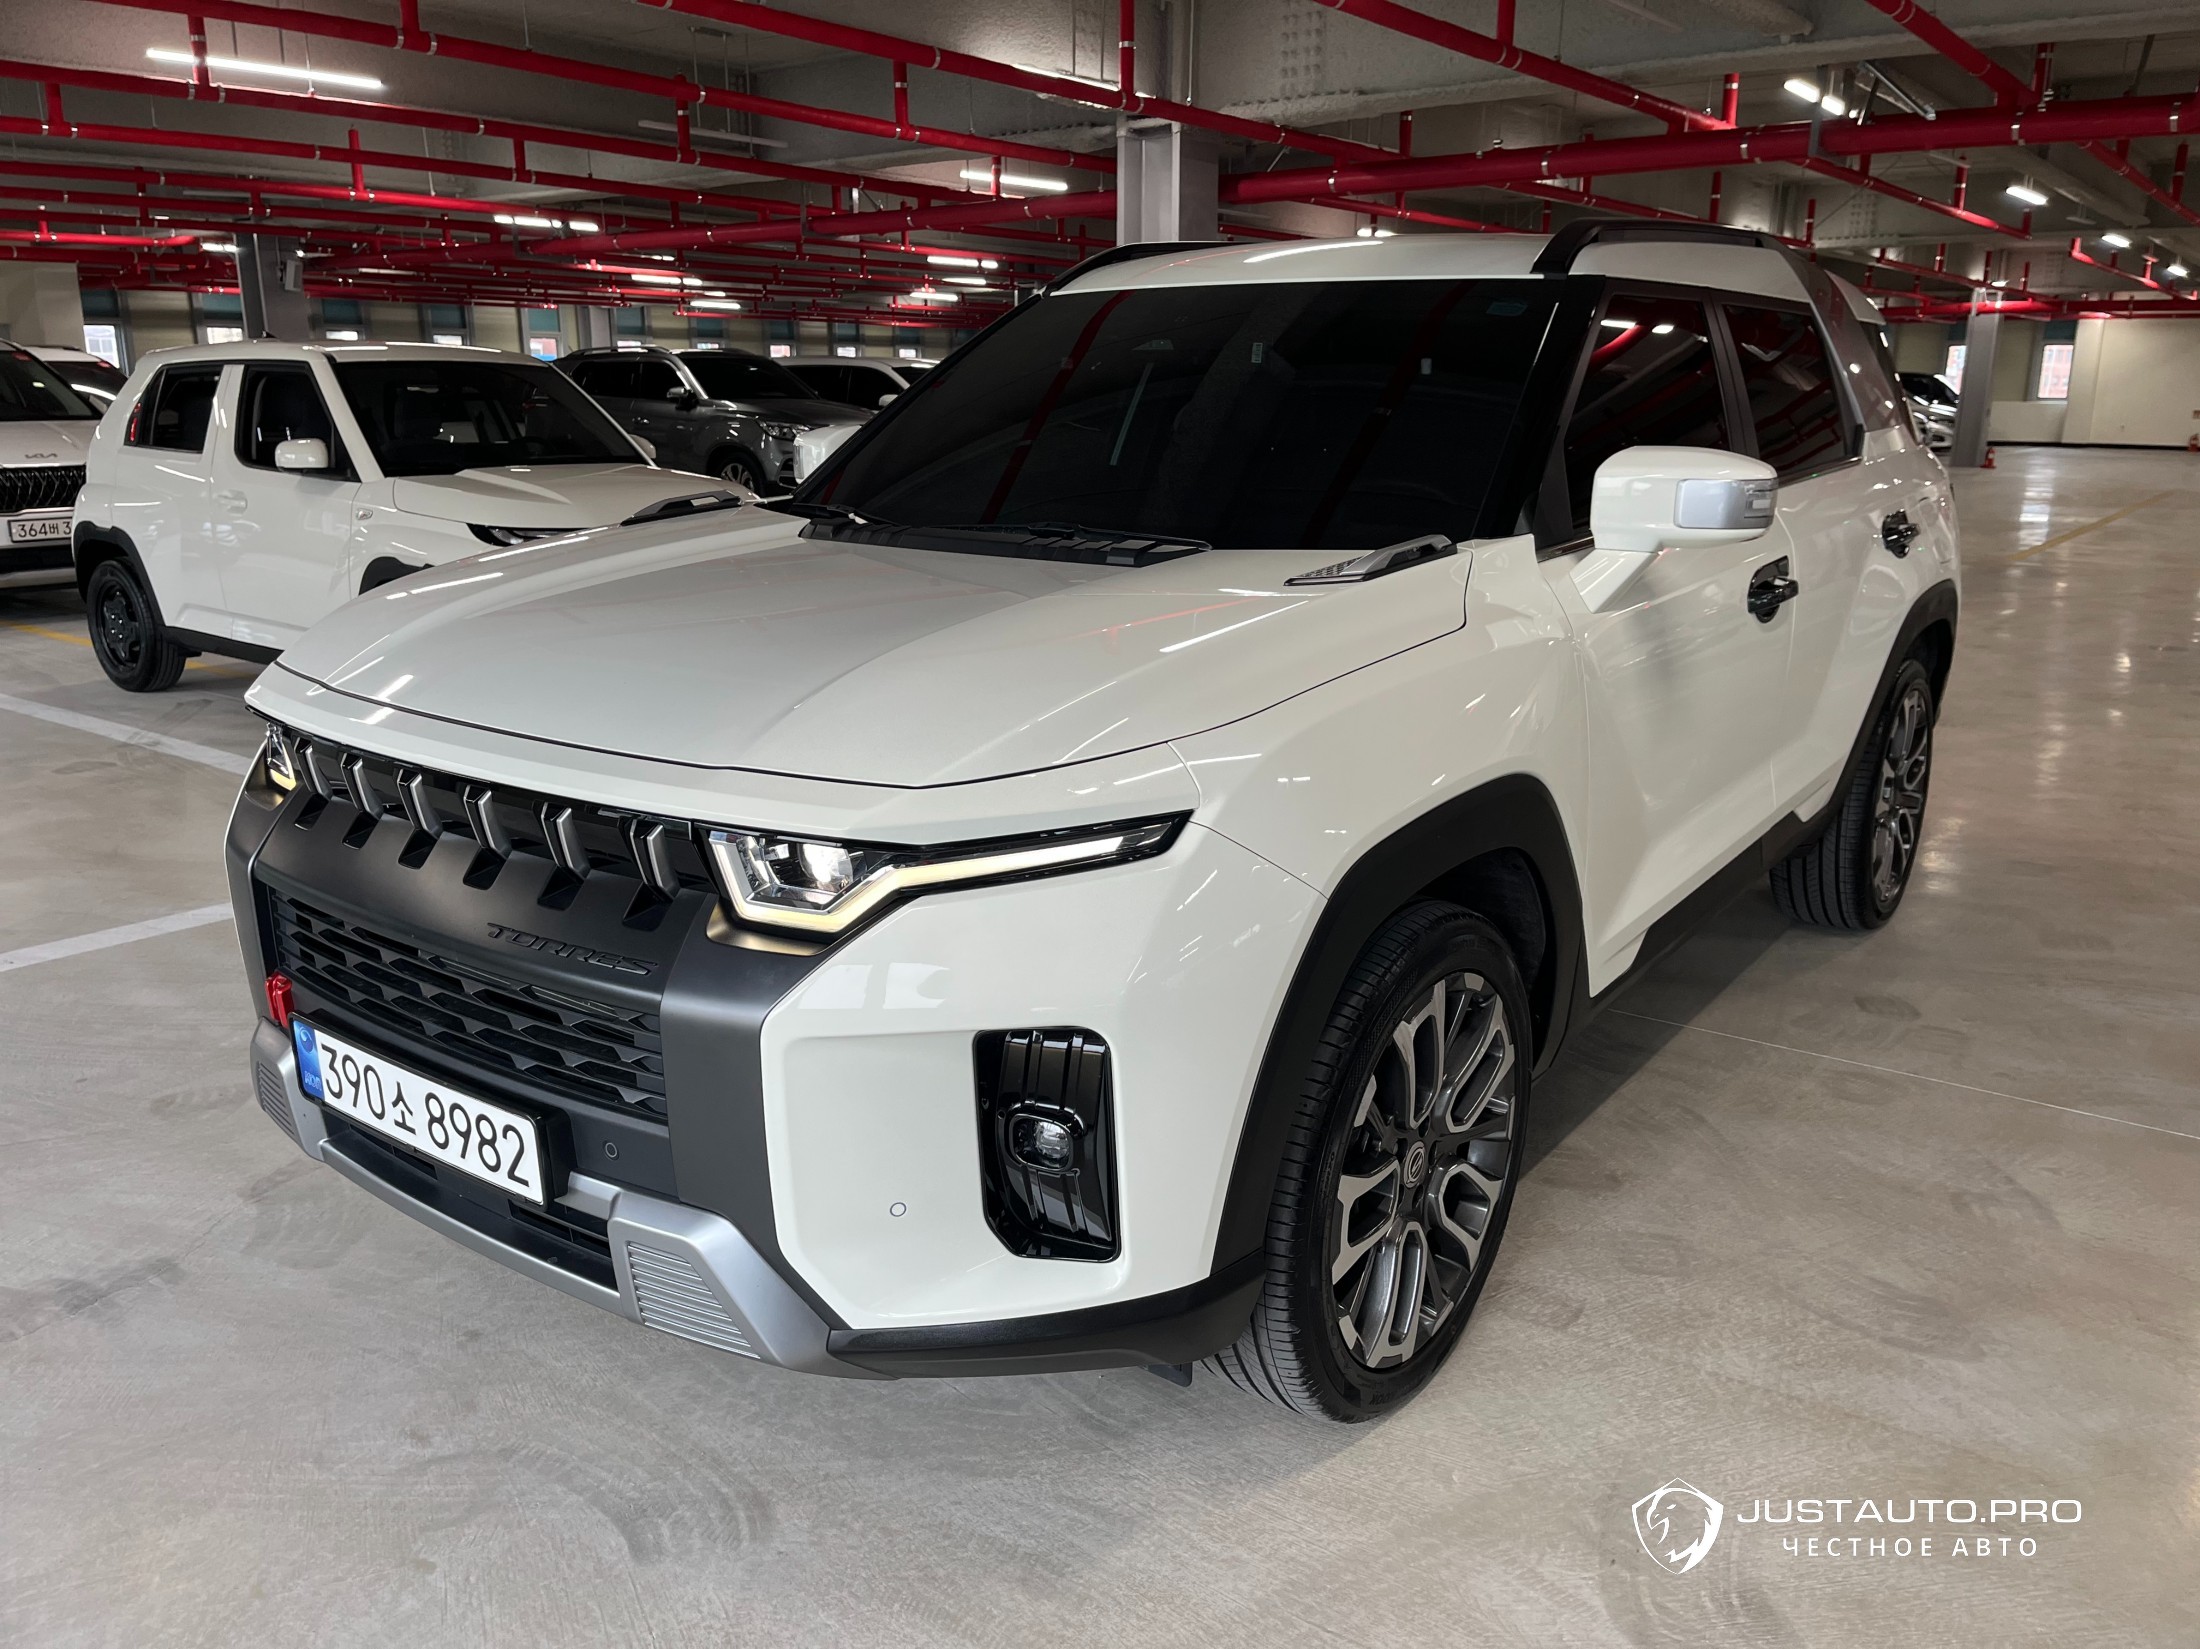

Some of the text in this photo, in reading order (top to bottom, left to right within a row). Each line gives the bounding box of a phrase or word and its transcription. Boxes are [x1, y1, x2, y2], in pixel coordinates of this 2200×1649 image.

[487, 922, 658, 976] TORRES
[321, 1043, 530, 1188] 390소 8982
